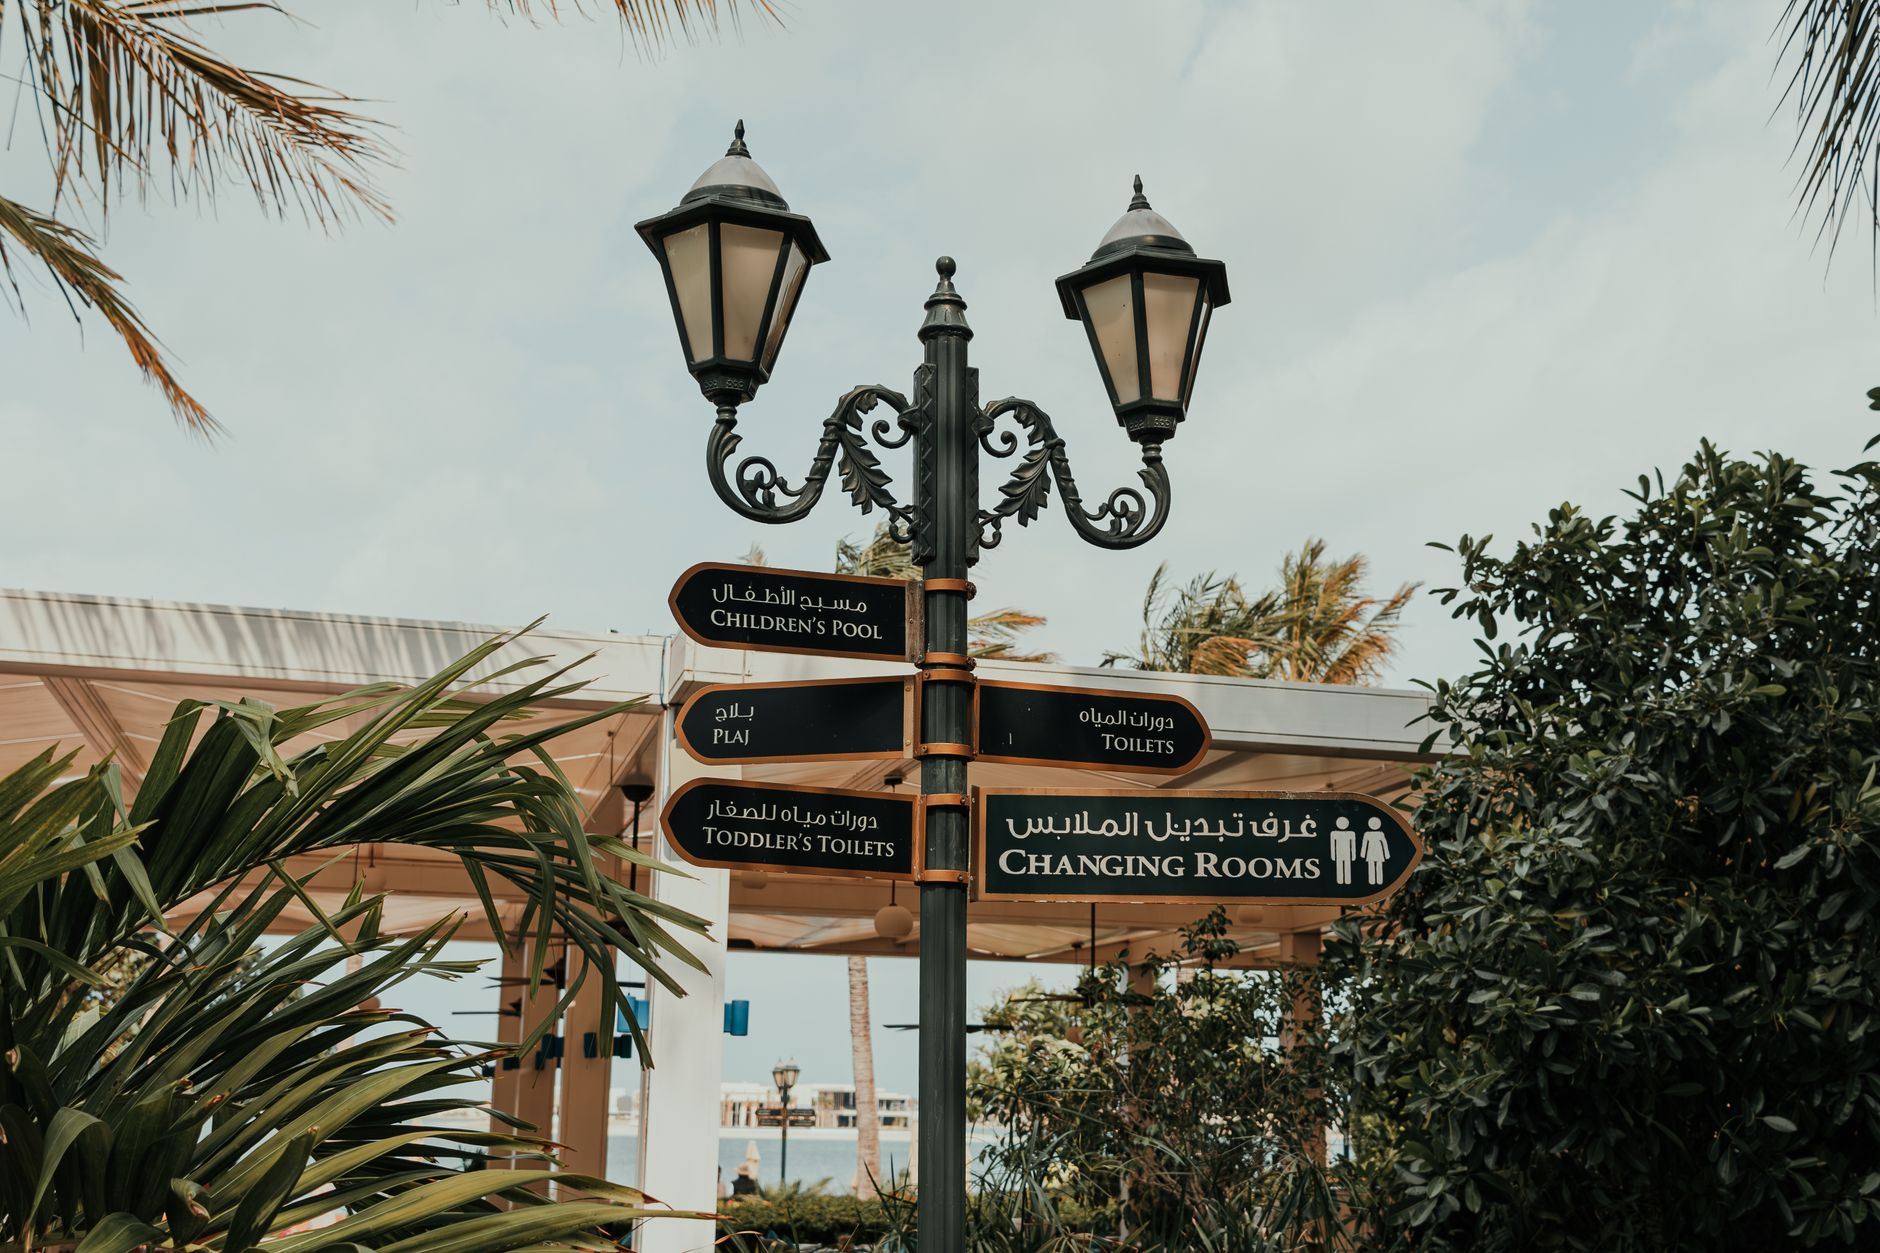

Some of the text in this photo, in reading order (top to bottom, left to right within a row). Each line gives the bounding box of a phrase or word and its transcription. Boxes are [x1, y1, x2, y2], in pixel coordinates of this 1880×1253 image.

[711, 583, 868, 614] مسبح الأطفال
[710, 608, 883, 640] CHILDREN'S POOL
[715, 702, 754, 723] بلاج
[1079, 707, 1127, 728] المياه
[712, 728, 750, 746] PLAJ
[1101, 733, 1174, 754] TOILETS
[706, 799, 878, 832] دورات مياه للصغار
[1005, 810, 1139, 841] الملابس
[1249, 811, 1318, 843] غرف
[702, 826, 895, 858] TODDLER'S TOILETS
[998, 847, 1321, 880] CHANGING ROOMS
